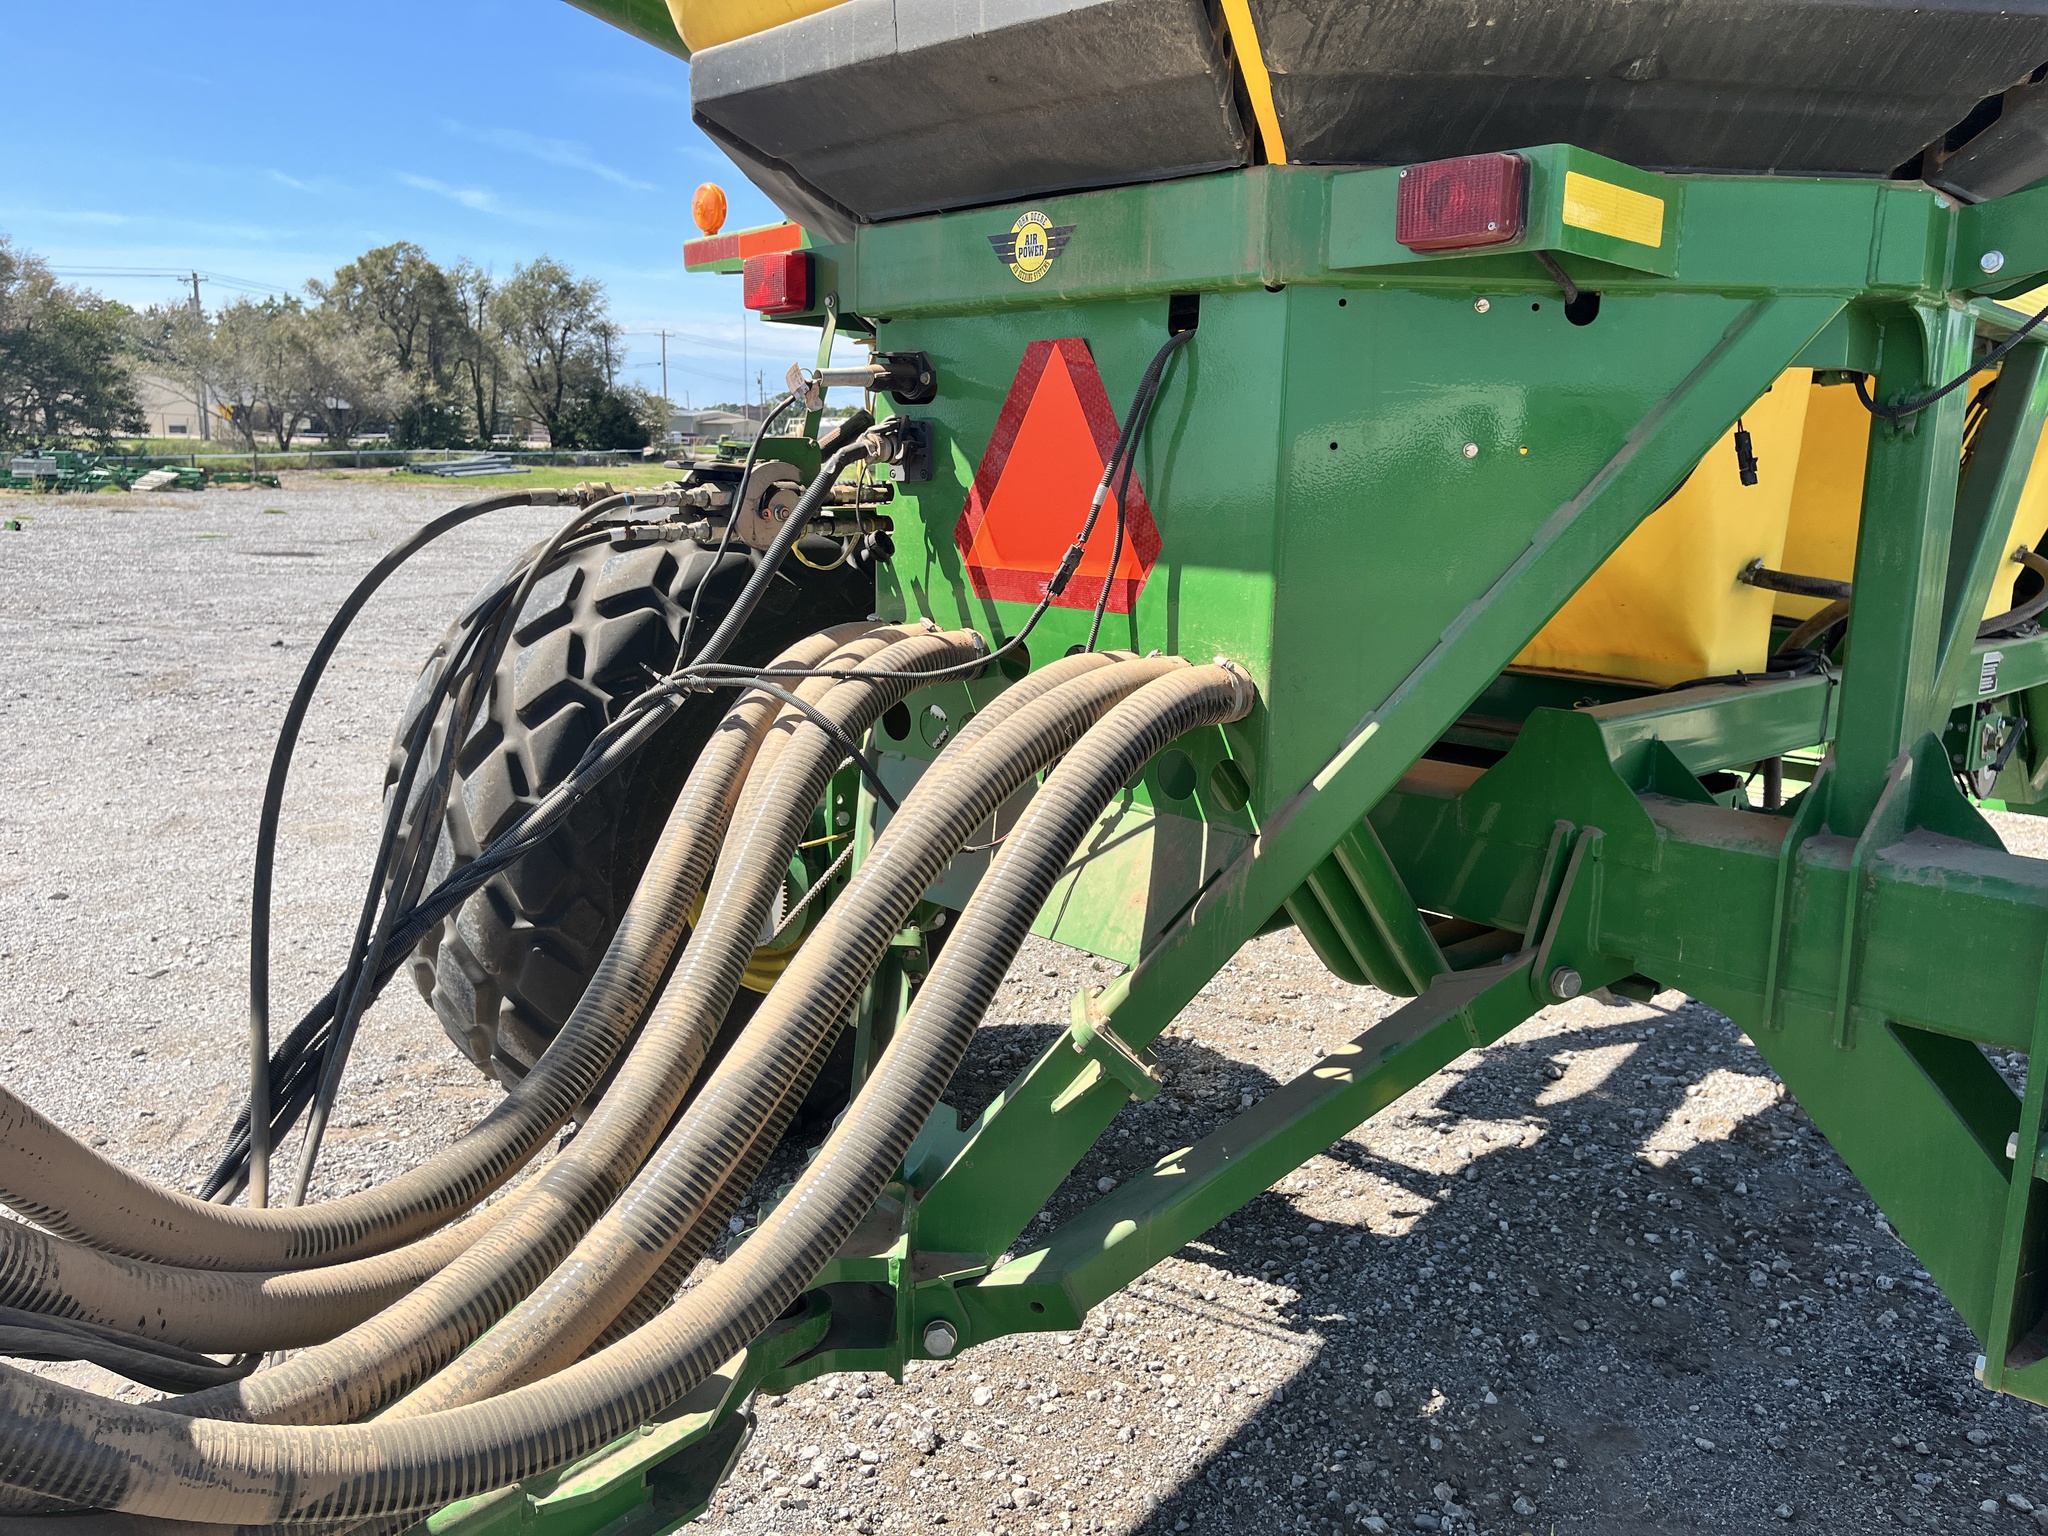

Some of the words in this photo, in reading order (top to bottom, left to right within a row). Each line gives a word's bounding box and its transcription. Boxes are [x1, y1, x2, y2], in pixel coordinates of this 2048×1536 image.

[1016, 214, 1029, 229] JOHN
[1030, 212, 1048, 226] DEERE
[1025, 233, 1038, 246] AIR
[1018, 244, 1045, 259] POWER
